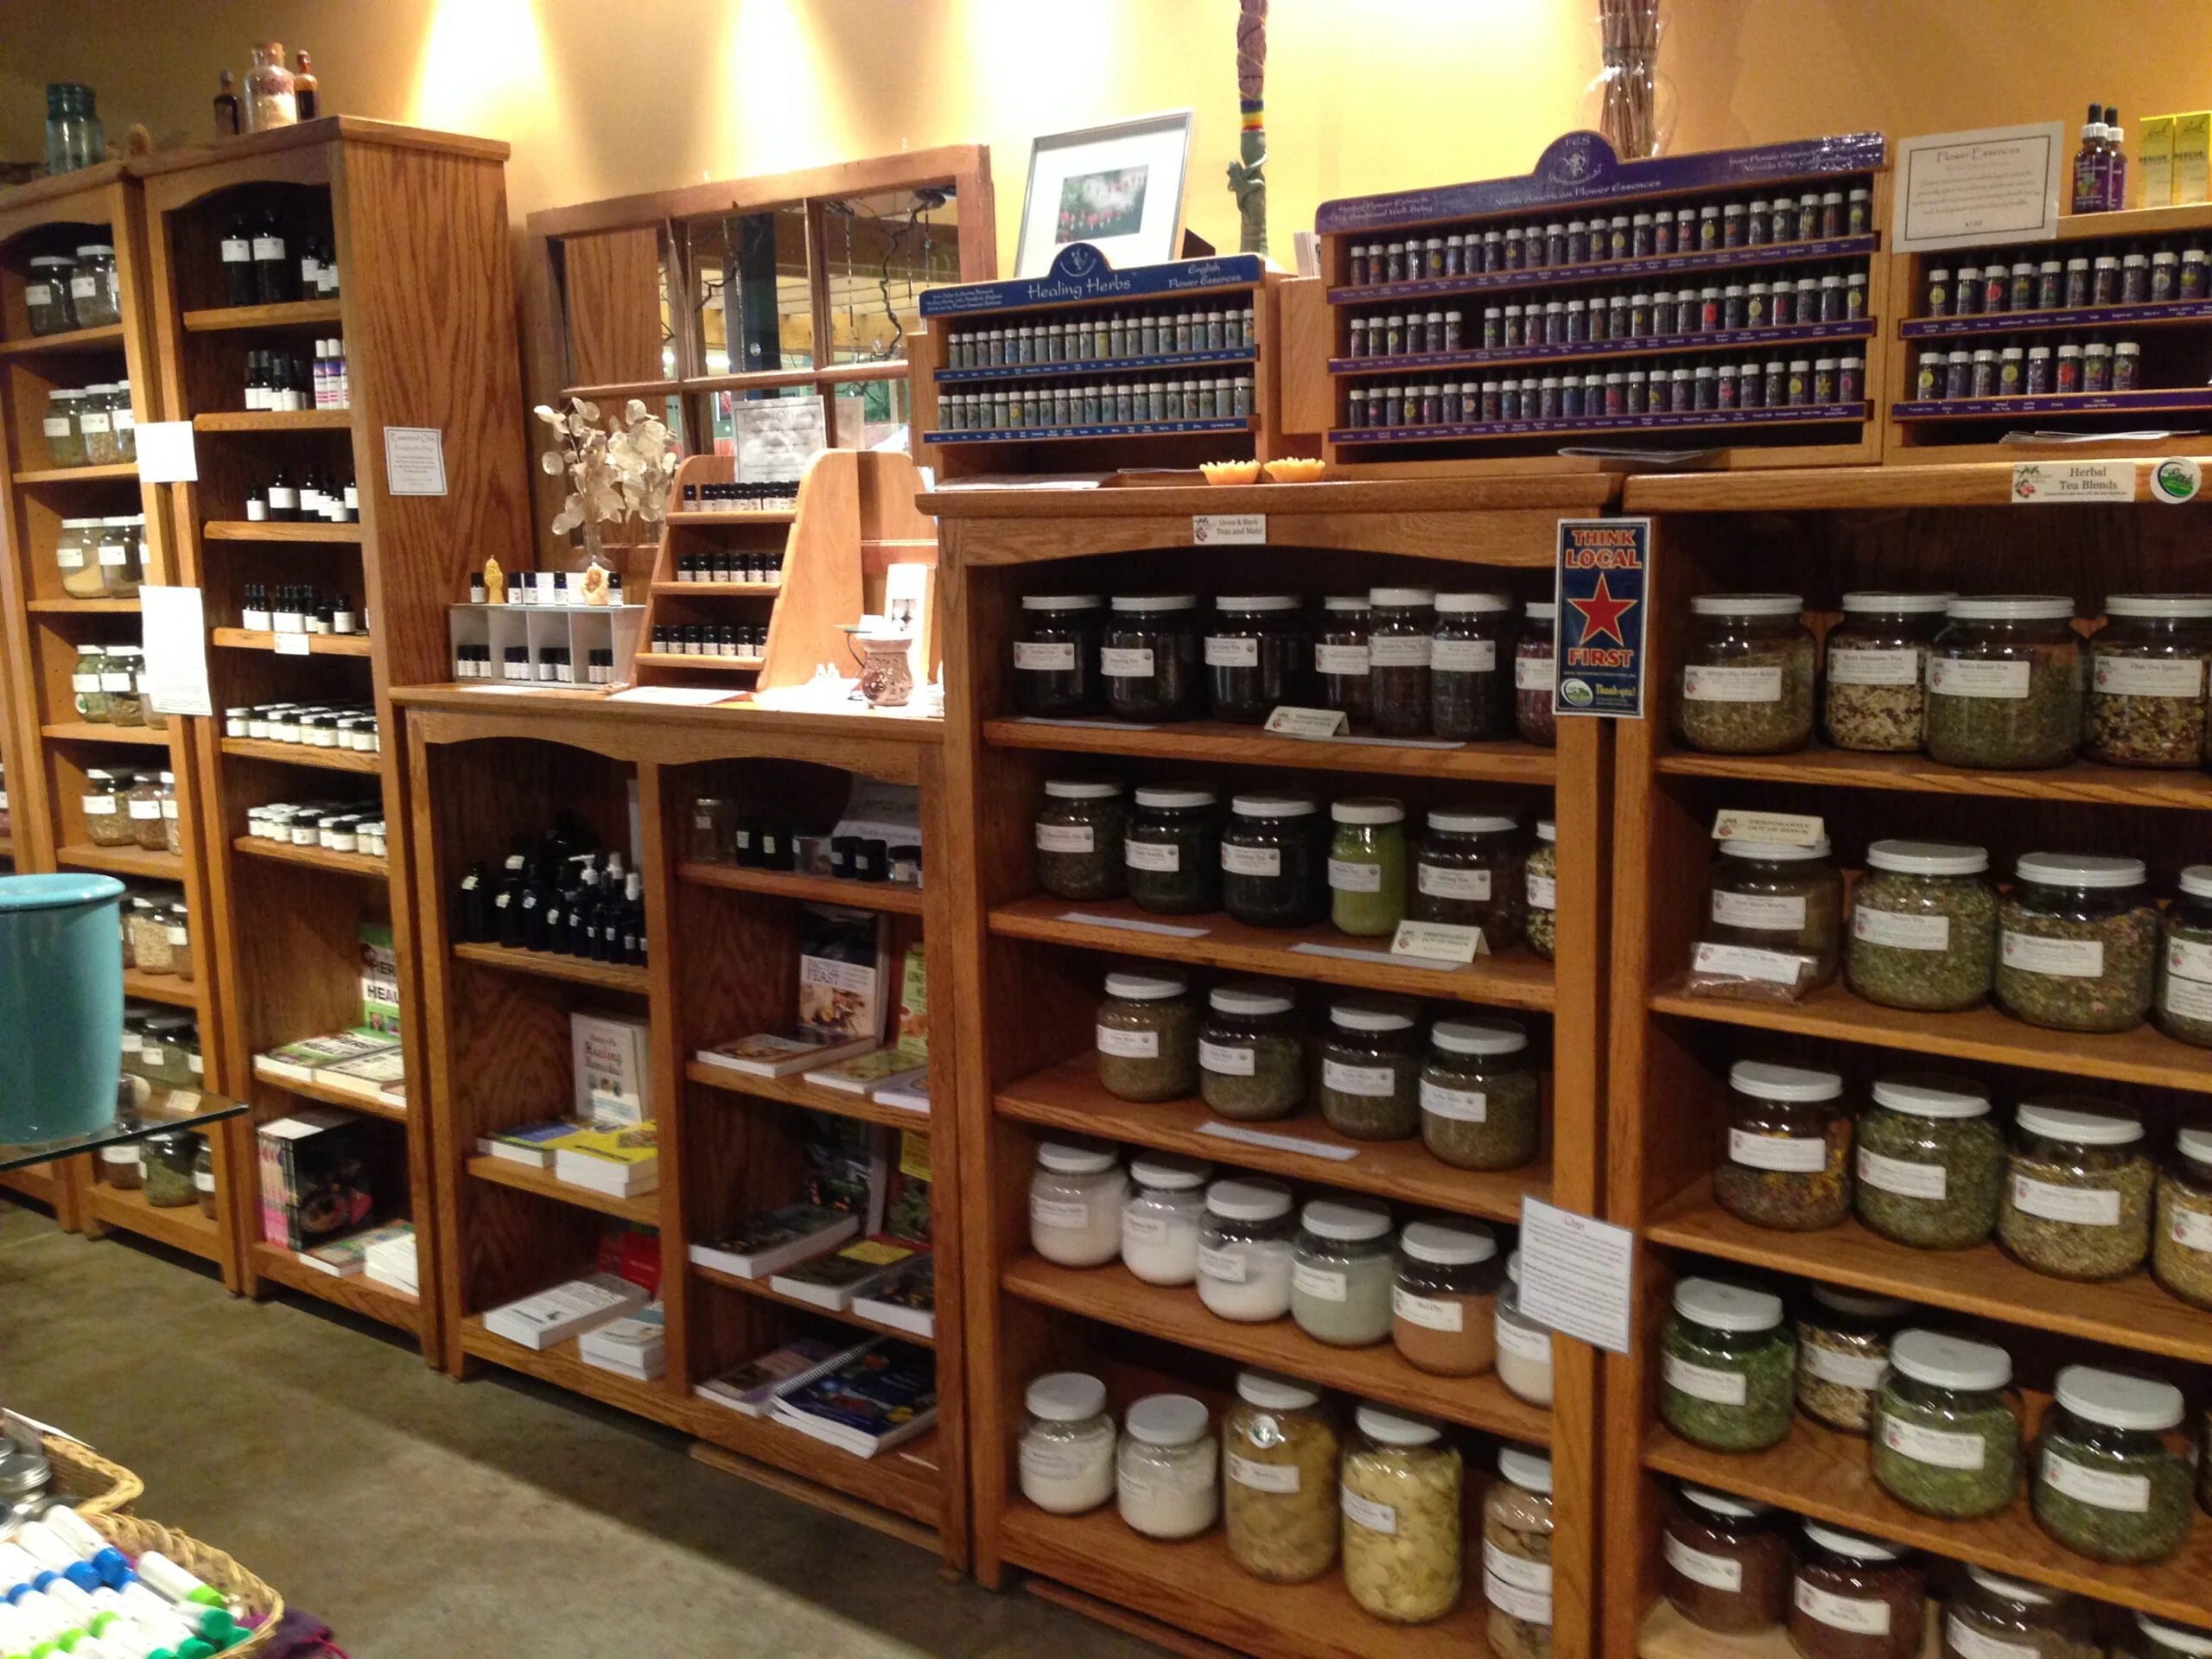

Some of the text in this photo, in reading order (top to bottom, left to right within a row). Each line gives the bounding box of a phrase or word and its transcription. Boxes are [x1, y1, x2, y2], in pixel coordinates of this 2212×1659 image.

[1936, 146, 2021, 163] Flower Essences
[1495, 180, 1662, 207] North American Flower Essences
[1187, 262, 1221, 276] English
[1027, 274, 1132, 300] Healing Herbs
[1168, 275, 1243, 289] Flower Essences
[2070, 467, 2107, 477] Herbal
[2059, 480, 2118, 490] Tea Blends
[1571, 529, 1637, 547] THINK
[1565, 549, 1642, 569] LOCAL
[1567, 647, 1635, 668] FIRST
[807, 969, 841, 985] FEAST
[584, 1039, 623, 1068] Healing
